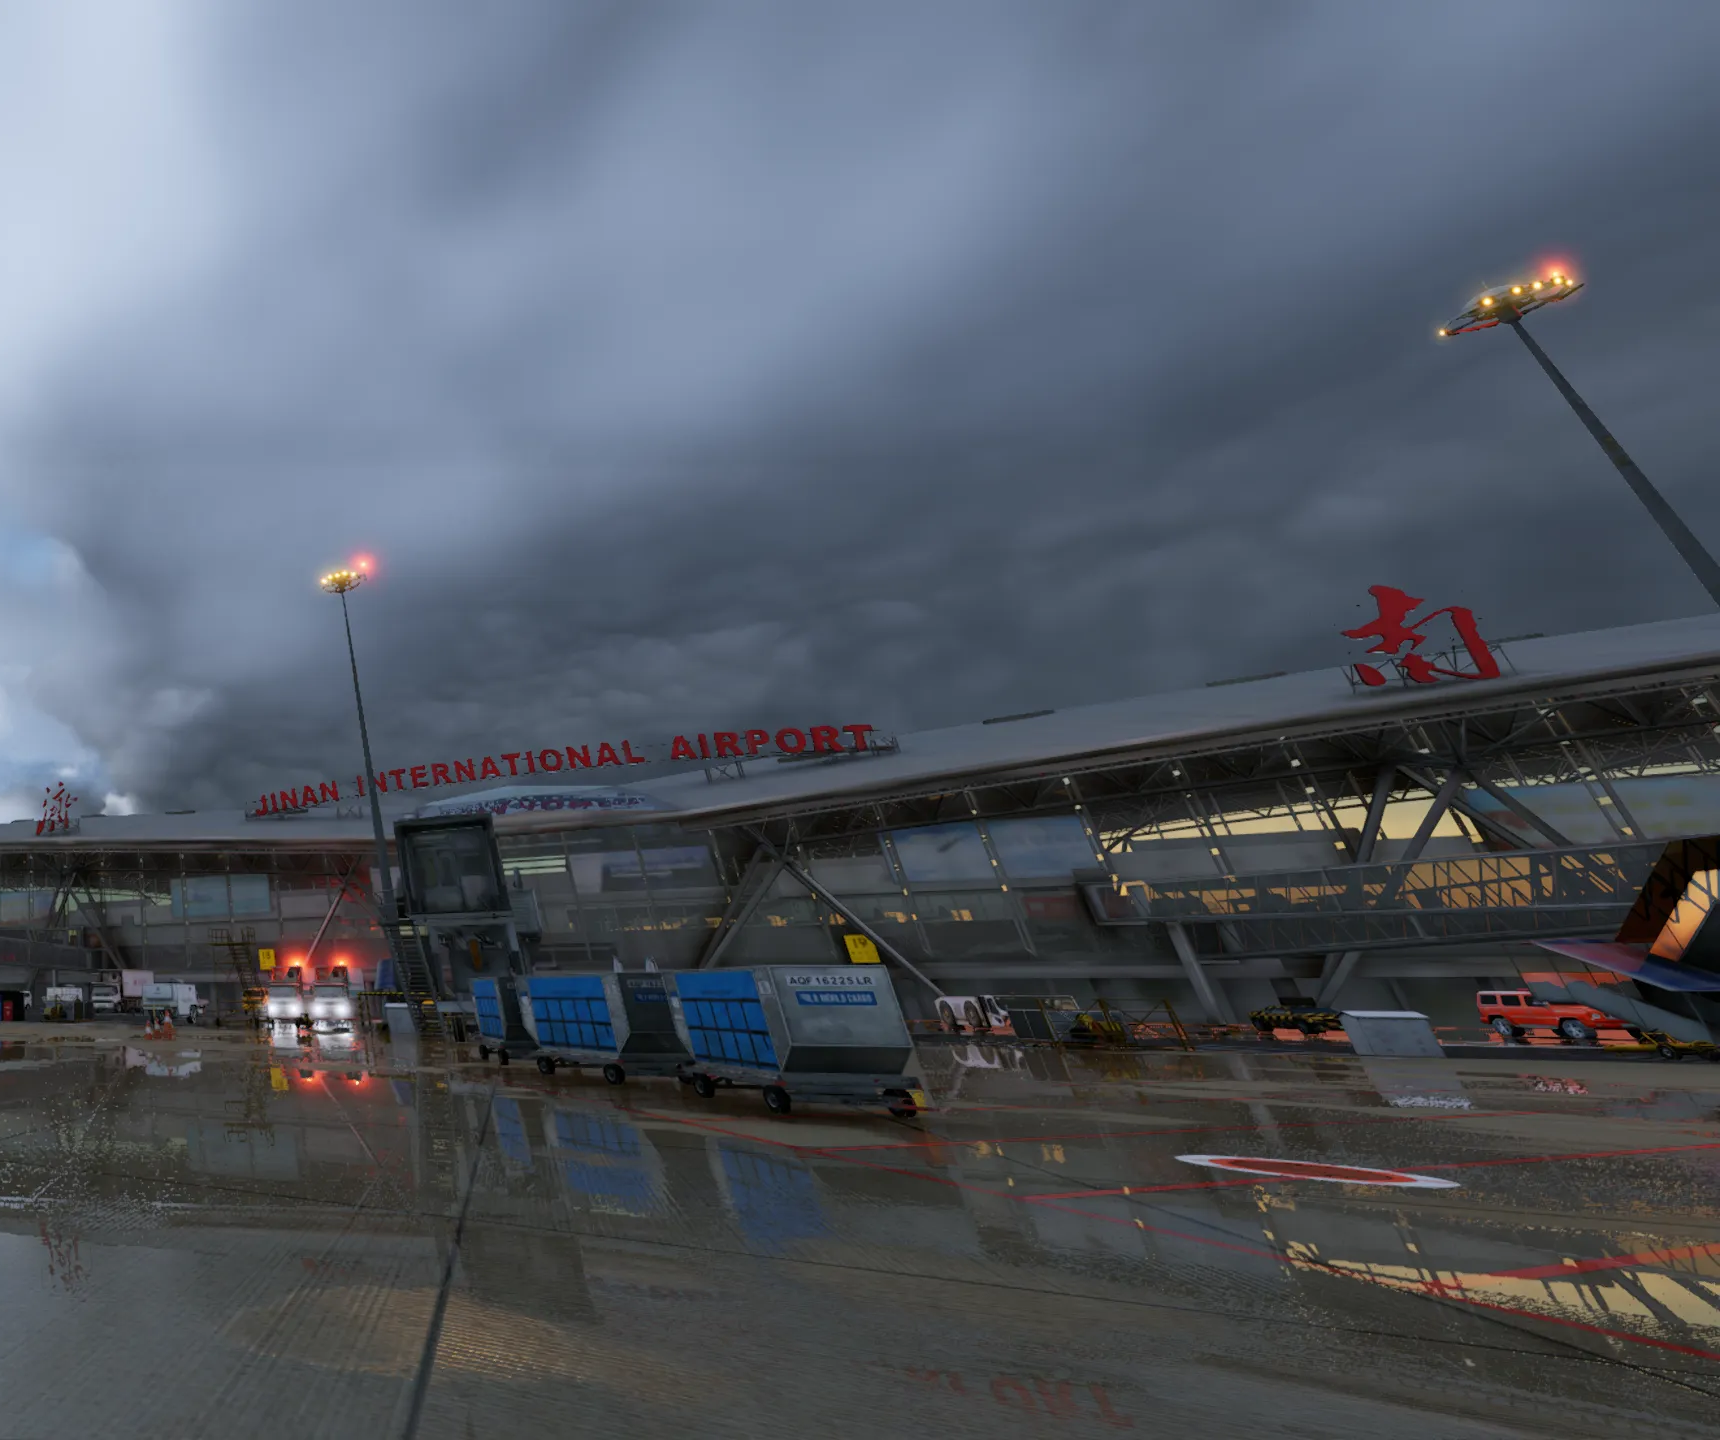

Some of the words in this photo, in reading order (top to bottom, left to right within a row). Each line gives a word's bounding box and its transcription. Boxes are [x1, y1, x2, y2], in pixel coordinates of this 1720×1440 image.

[256, 780, 339, 816] JINAN
[357, 741, 645, 797] INTERNATIONAL
[671, 725, 874, 760] AIRPORT
